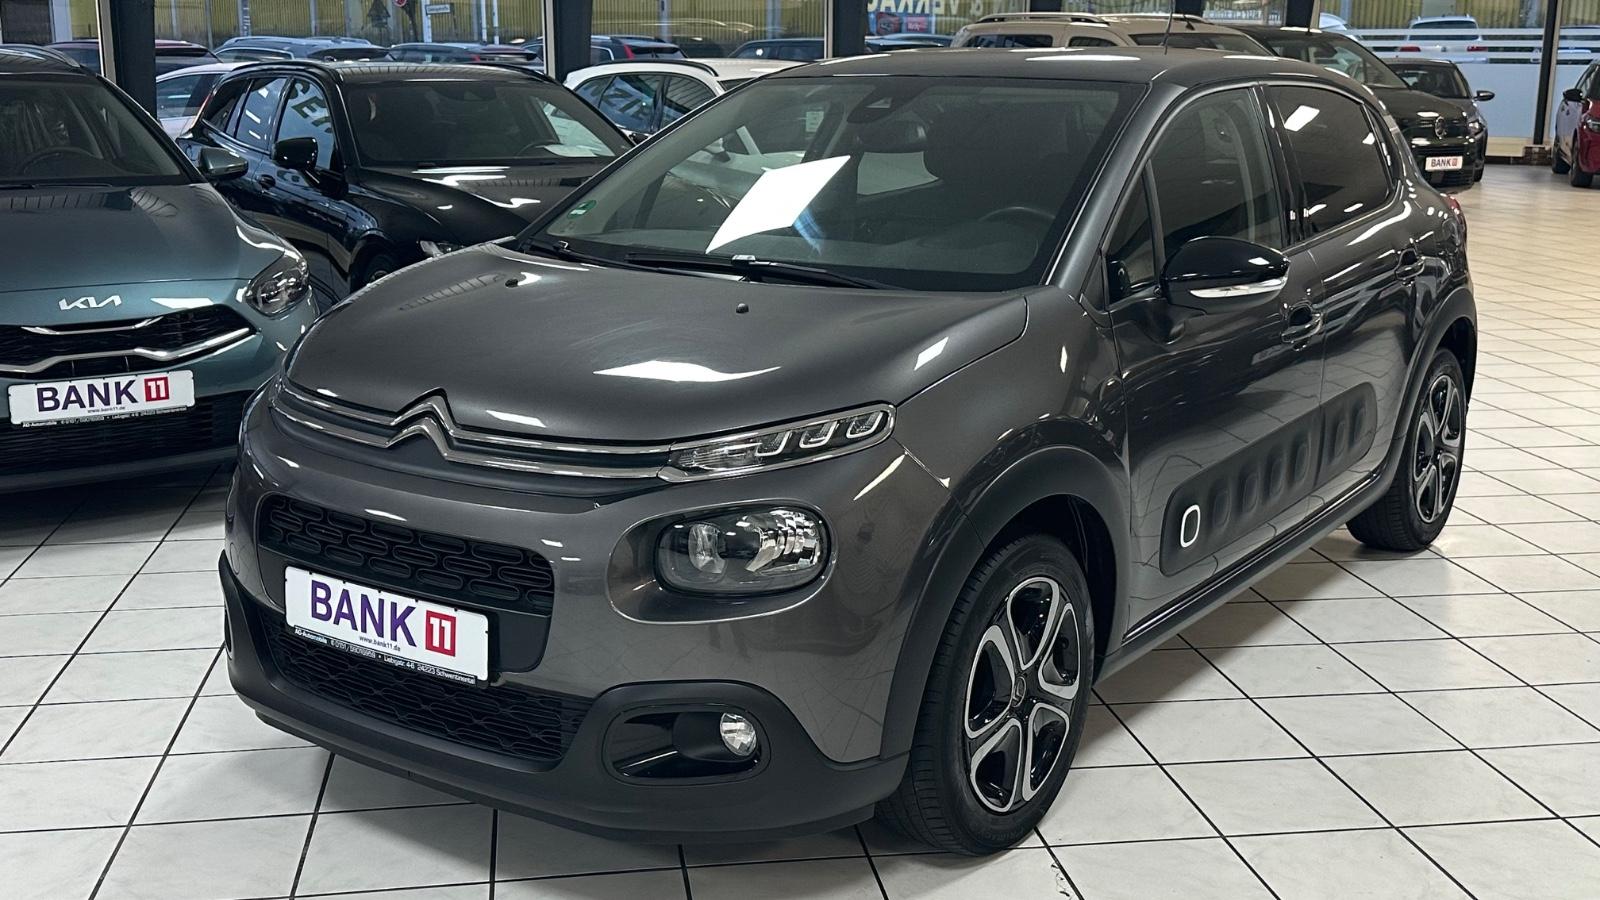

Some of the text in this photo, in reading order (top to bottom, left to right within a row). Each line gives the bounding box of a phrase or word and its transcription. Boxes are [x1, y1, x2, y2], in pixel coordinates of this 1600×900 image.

[1431, 158, 1451, 168] BANK
[58, 295, 122, 311] KIA
[37, 378, 168, 412] BANK 11
[311, 579, 454, 653] BANK 11
[359, 635, 401, 651] www.bank11.de
